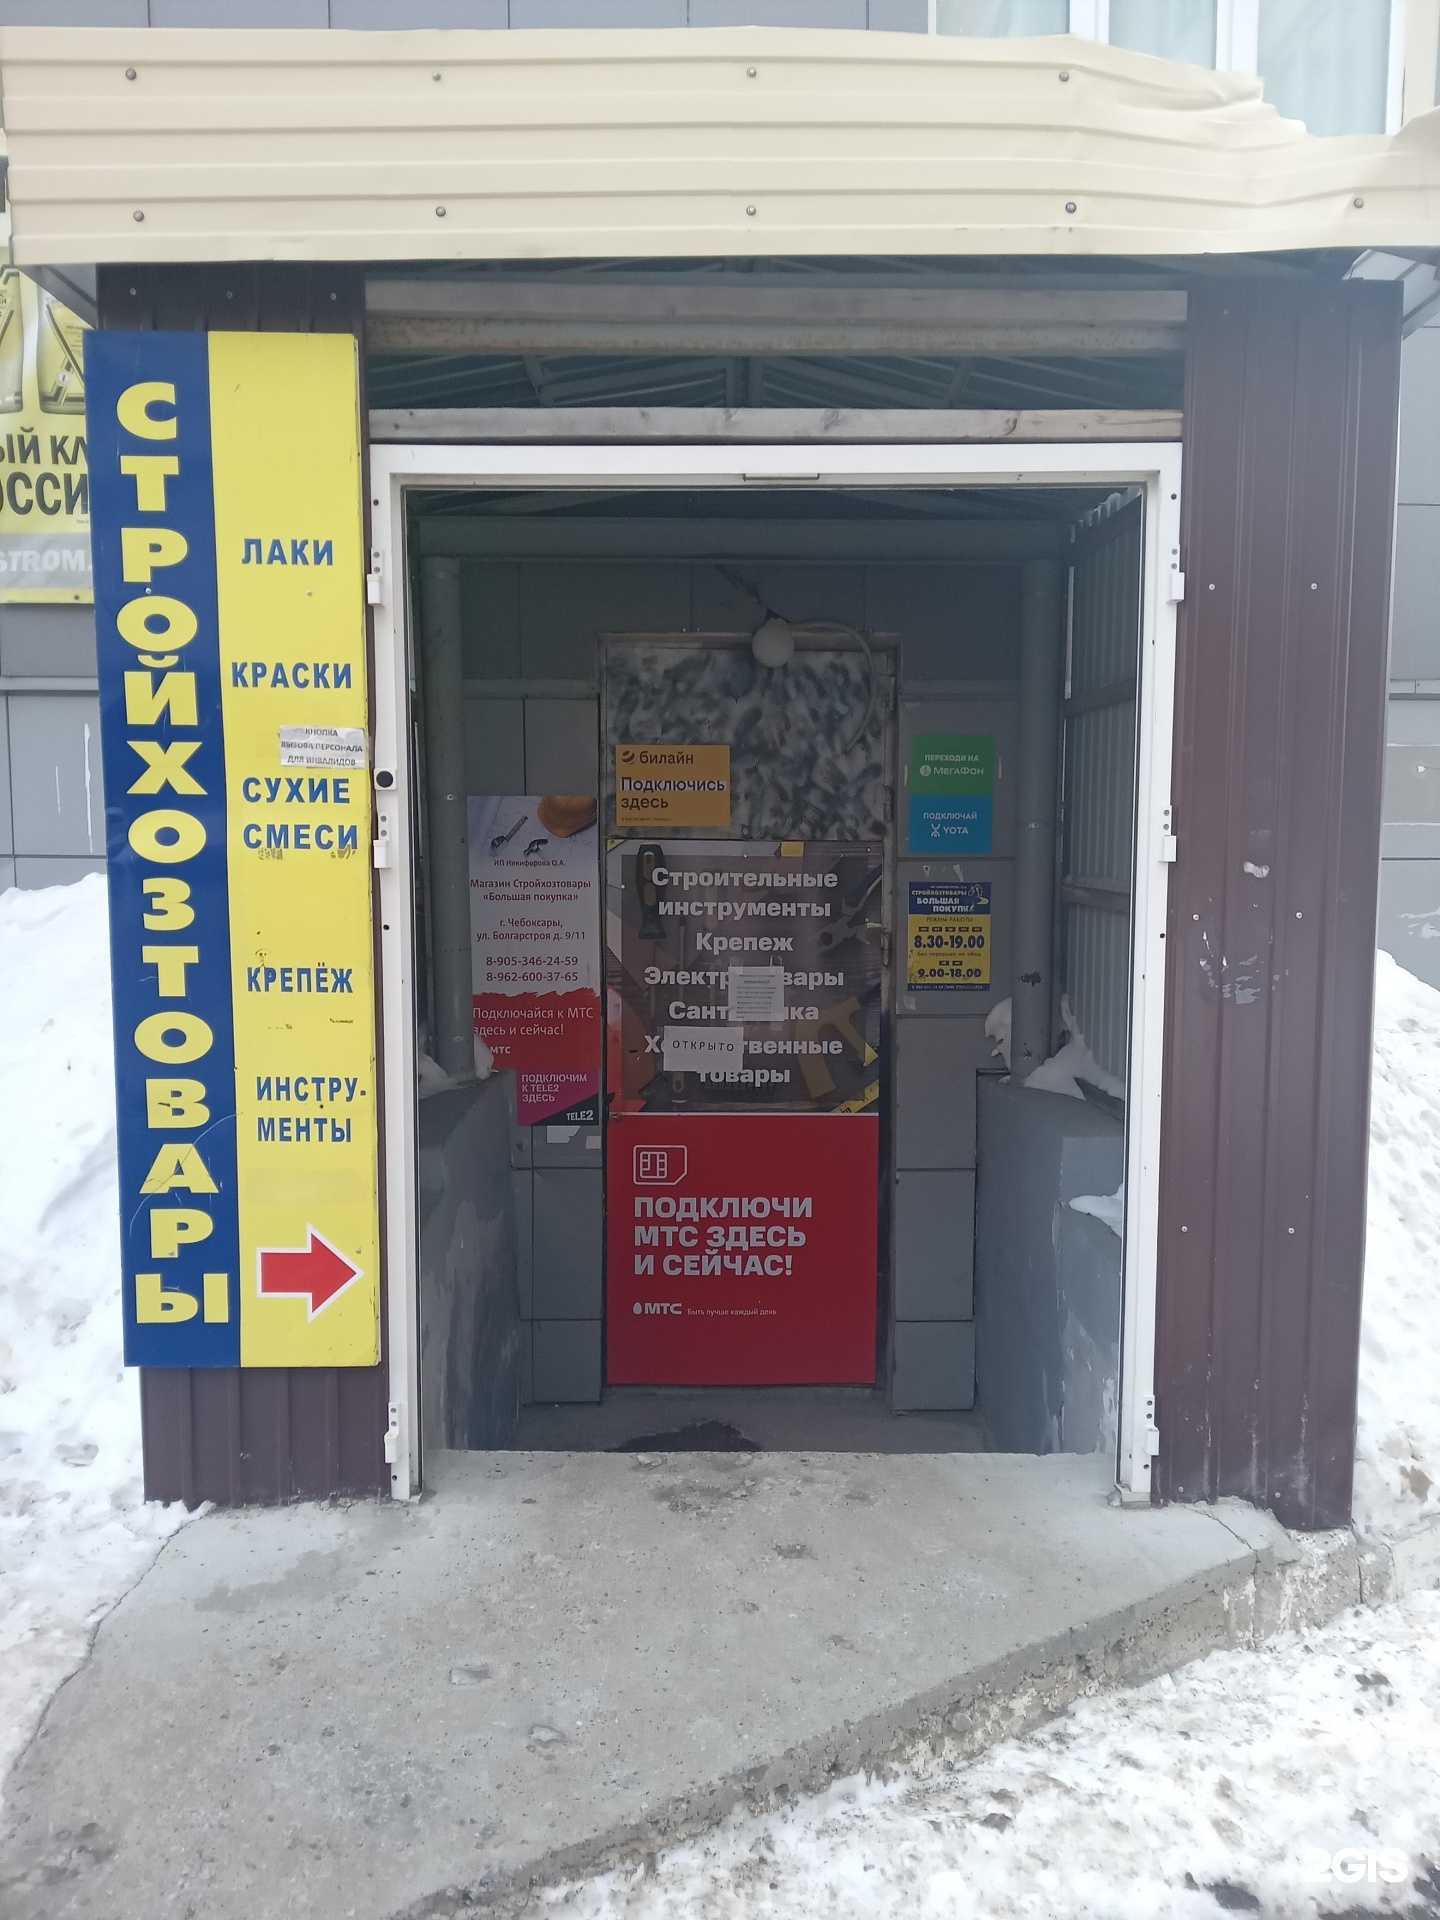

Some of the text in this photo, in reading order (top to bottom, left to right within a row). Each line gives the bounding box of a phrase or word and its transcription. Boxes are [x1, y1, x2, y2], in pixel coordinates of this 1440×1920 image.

[0, 471, 89, 516] ССИ
[241, 538, 334, 567] ЛАКИ
[231, 661, 352, 690] КРАСКИ
[305, 727, 338, 737] КНОПКА
[315, 742, 363, 752] ПЕРСОНАЛА
[306, 755, 356, 766] ИНВАЛИДОВ
[639, 750, 694, 765] билайн
[242, 777, 351, 804] СУХИЕ
[621, 776, 726, 793] Подключись
[621, 797, 669, 810] здесь
[923, 810, 978, 820] ПОДКЛЮЧАЙ
[243, 823, 358, 850] СМЕСИ
[943, 826, 969, 835] YOTA
[115, 381, 229, 1324] СТРОЙХОЗТОВАРЫ
[470, 878, 592, 890] Магазин Стройхозтовары
[652, 866, 839, 890] Строительные
[483, 891, 579, 904] «Большая покупка»
[658, 899, 832, 921] инструменты
[508, 918, 563, 929] Чебоксары,
[476, 932, 490, 942] ул.
[493, 931, 551, 942] Болгарстроя
[565, 931, 586, 940] 9/11
[696, 931, 794, 955] Крепеж
[914, 934, 985, 949] 8.30-19.00
[486, 956, 578, 966] 8-905-346-24-59
[246, 963, 354, 994] КРЕПЁЖ
[486, 972, 578, 982] 8-962-600-37-65
[644, 966, 844, 990] Электрвары
[917, 968, 982, 978] 9.00-18.00
[472, 1007, 594, 1020] Подключайся к МТС
[509, 1026, 517, 1035] и
[520, 1023, 564, 1036] сейчас!
[672, 1039, 735, 1052] ОТКРЫТО
[521, 1073, 588, 1084] ПОДКЛЮЧИМ
[521, 1084, 560, 1093] К TELE2
[521, 1094, 556, 1103] ЗДЕСЬ
[566, 1109, 594, 1121] TELE2
[256, 1116, 352, 1143] МЕНТЫ
[634, 1197, 813, 1222] ПОДКЛЮЧИ
[634, 1226, 806, 1251] МТС ЗДЕСЬ
[634, 1248, 792, 1276] И СЕЙЧАС!
[644, 1302, 683, 1315] МТС
